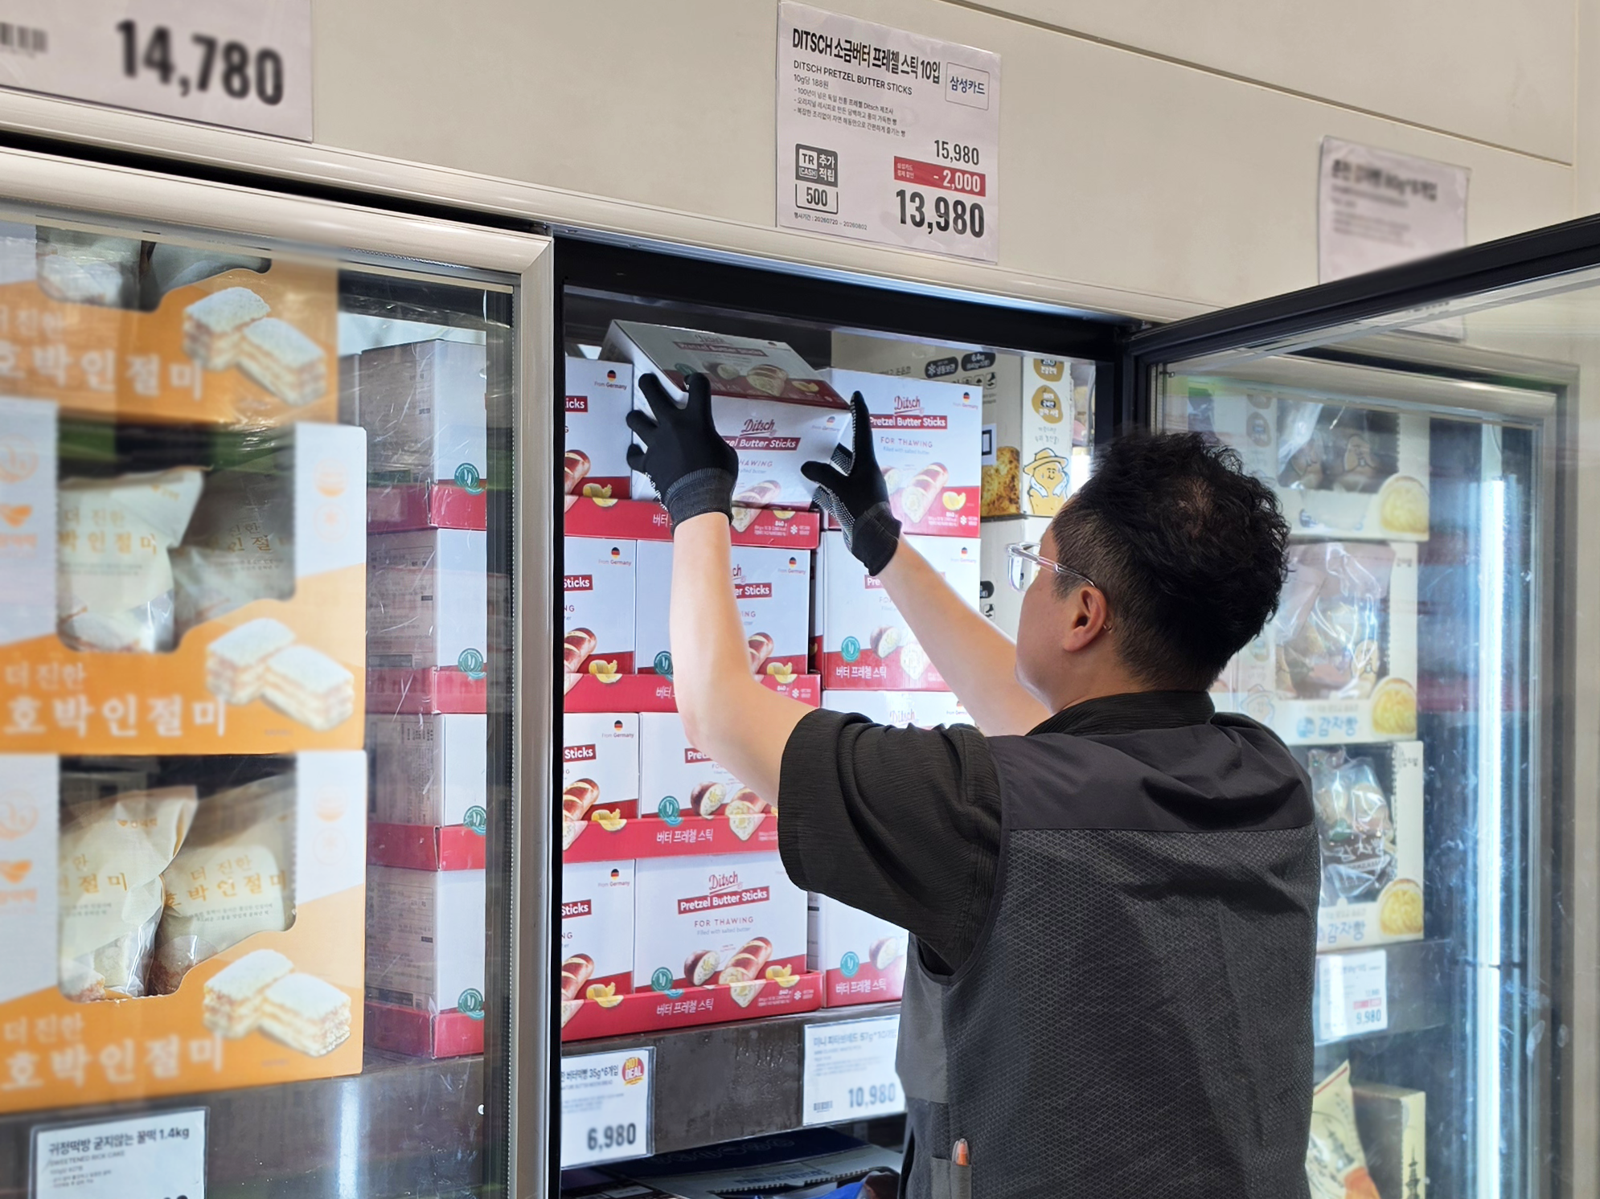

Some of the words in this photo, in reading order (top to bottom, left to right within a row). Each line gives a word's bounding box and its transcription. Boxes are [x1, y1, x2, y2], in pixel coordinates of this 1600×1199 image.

[116, 19, 284, 106] 14,780
[792, 28, 833, 57] DITSCH
[834, 38, 871, 68] 소금버터
[872, 47, 900, 75] 프레첼
[901, 54, 919, 79] 스틱
[921, 59, 941, 84] 10입
[794, 60, 822, 75] DITSCH
[824, 67, 855, 82] PRETZEL
[857, 75, 885, 89] BUTTER
[887, 82, 912, 95] STICKS
[794, 74, 811, 85] 10g당
[812, 78, 829, 90] 188원
[950, 76, 985, 95] 삼성카드
[864, 103, 879, 111] Ditsch
[802, 153, 815, 166] TR
[819, 154, 835, 168] 추가
[934, 140, 979, 166] 15,980
[801, 167, 817, 176] CASH
[819, 168, 835, 182] 적립
[943, 169, 981, 193] 2,000
[806, 186, 828, 207] 500
[896, 189, 985, 238] 13,980
[606, 382, 628, 391] Germany
[893, 395, 921, 411] Ditsch
[740, 418, 775, 433] Ditsch
[870, 416, 895, 427] Pretzel
[897, 417, 921, 427] Butter
[923, 416, 946, 427] Sticks
[740, 438, 769, 448] Butter
[769, 438, 797, 449] Sticks
[880, 436, 895, 444] FOR
[898, 438, 933, 448] THAWING
[652, 513, 669, 528] 버터
[744, 585, 770, 595] Sticks
[836, 666, 850, 679] 버터
[851, 665, 872, 679] 프레첼
[873, 666, 887, 678] 스틱
[656, 685, 672, 700] 버터
[2, 692, 227, 738] 호박인절미
[1319, 715, 1358, 738] 감자빵
[564, 747, 594, 759] Sticks
[656, 830, 673, 844] 버터
[673, 829, 697, 843] 프레첼
[698, 828, 714, 842] 스틱
[191, 867, 207, 881] 더
[217, 854, 252, 876] 진한
[709, 871, 739, 890] Ditsch
[681, 896, 710, 911] Pretzel
[712, 894, 740, 907] Butter
[742, 889, 768, 902] Sticks
[562, 902, 589, 916] Sticks
[694, 920, 711, 928] FOR
[715, 916, 754, 926] THAWING
[1327, 920, 1366, 944] 감자빵
[836, 981, 850, 995] 버터
[851, 979, 870, 993] 프레첼
[872, 977, 887, 991] 스틱
[656, 1004, 672, 1016] 버터
[673, 1000, 697, 1014] 프레첼
[698, 998, 714, 1011] 스틱
[1356, 1008, 1382, 1025] 9,980
[813, 1035, 826, 1047] 미니
[0, 1031, 224, 1091] 호박인절미
[626, 1057, 639, 1069] HOT
[626, 1066, 643, 1079] DEAL
[848, 1082, 896, 1108] 10,980
[94, 1132, 134, 1151] 굳지않는
[137, 1129, 157, 1144] 꿀떡
[159, 1127, 190, 1140] 1.4kg
[587, 1123, 637, 1153] 6,980
